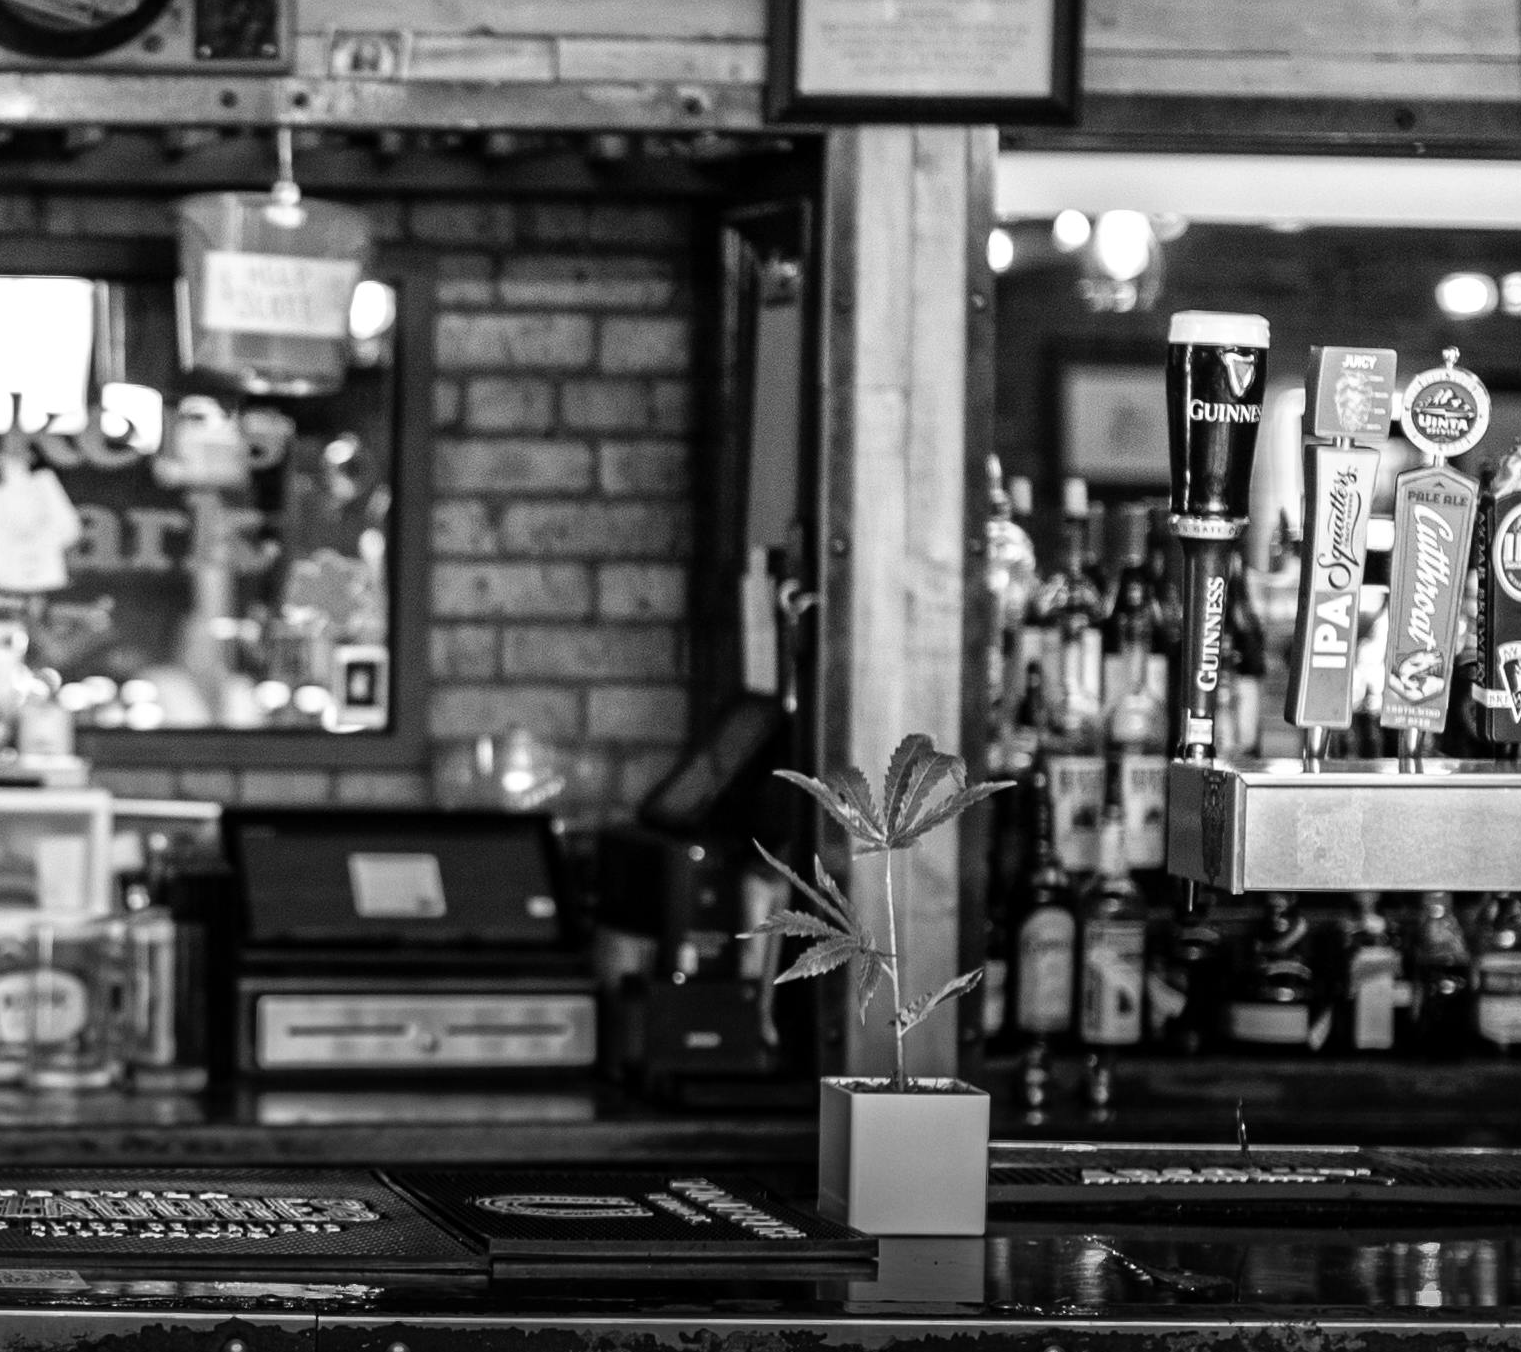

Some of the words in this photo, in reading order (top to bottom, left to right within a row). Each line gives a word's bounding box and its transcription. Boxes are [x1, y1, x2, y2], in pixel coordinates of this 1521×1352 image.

[1342, 354, 1377, 369] JUICY
[1189, 398, 1262, 424] GUINNES
[1418, 416, 1468, 432] UINTA
[1407, 490, 1441, 506] PALE
[1444, 492, 1469, 507] ALE
[1318, 467, 1359, 590] Squatters
[1197, 575, 1225, 693] GUINNESS
[1312, 594, 1353, 670] IPA
